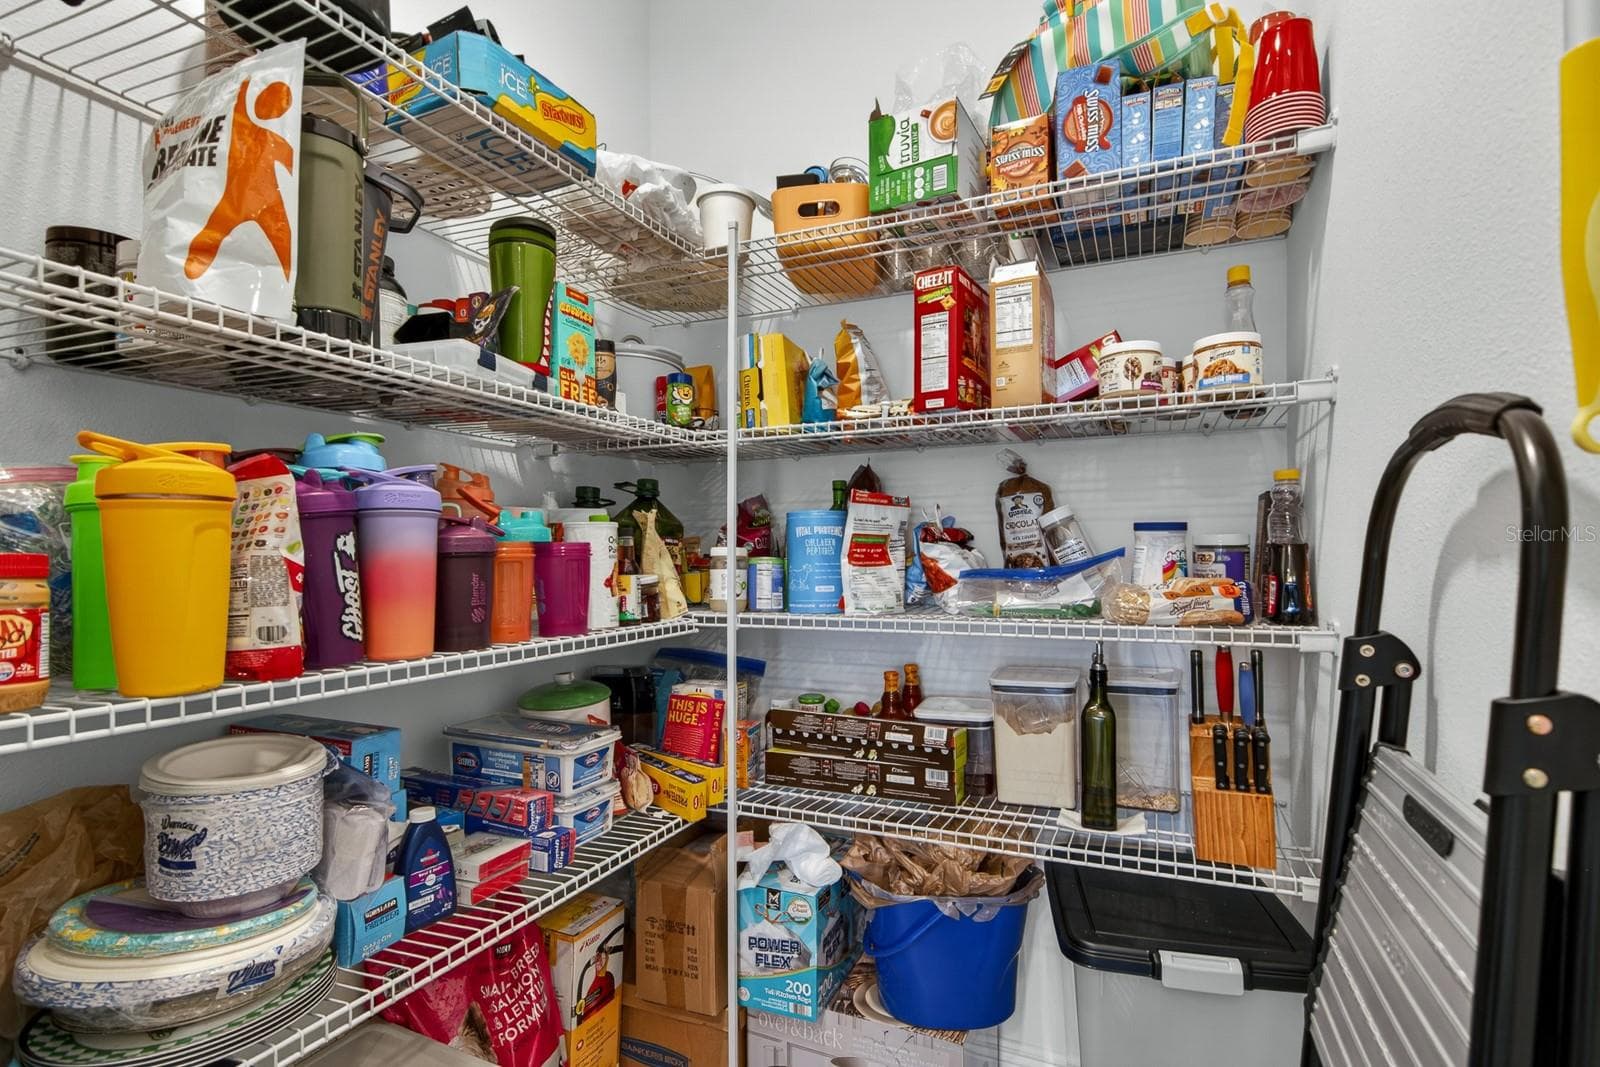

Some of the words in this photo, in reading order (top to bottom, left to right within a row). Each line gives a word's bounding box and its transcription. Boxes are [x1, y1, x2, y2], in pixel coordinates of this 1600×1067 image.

[500, 67, 528, 100] ICE
[897, 116, 910, 165] truvia
[364, 208, 387, 303] STANLEY
[916, 270, 954, 291] CHEEZ-IT
[560, 381, 598, 406] FREE
[670, 698, 695, 713] THIS
[695, 701, 708, 715] IS
[748, 936, 801, 955] POWER
[755, 952, 793, 969] FLEX
[491, 963, 540, 1013] SALMON
[785, 980, 812, 996] 200
